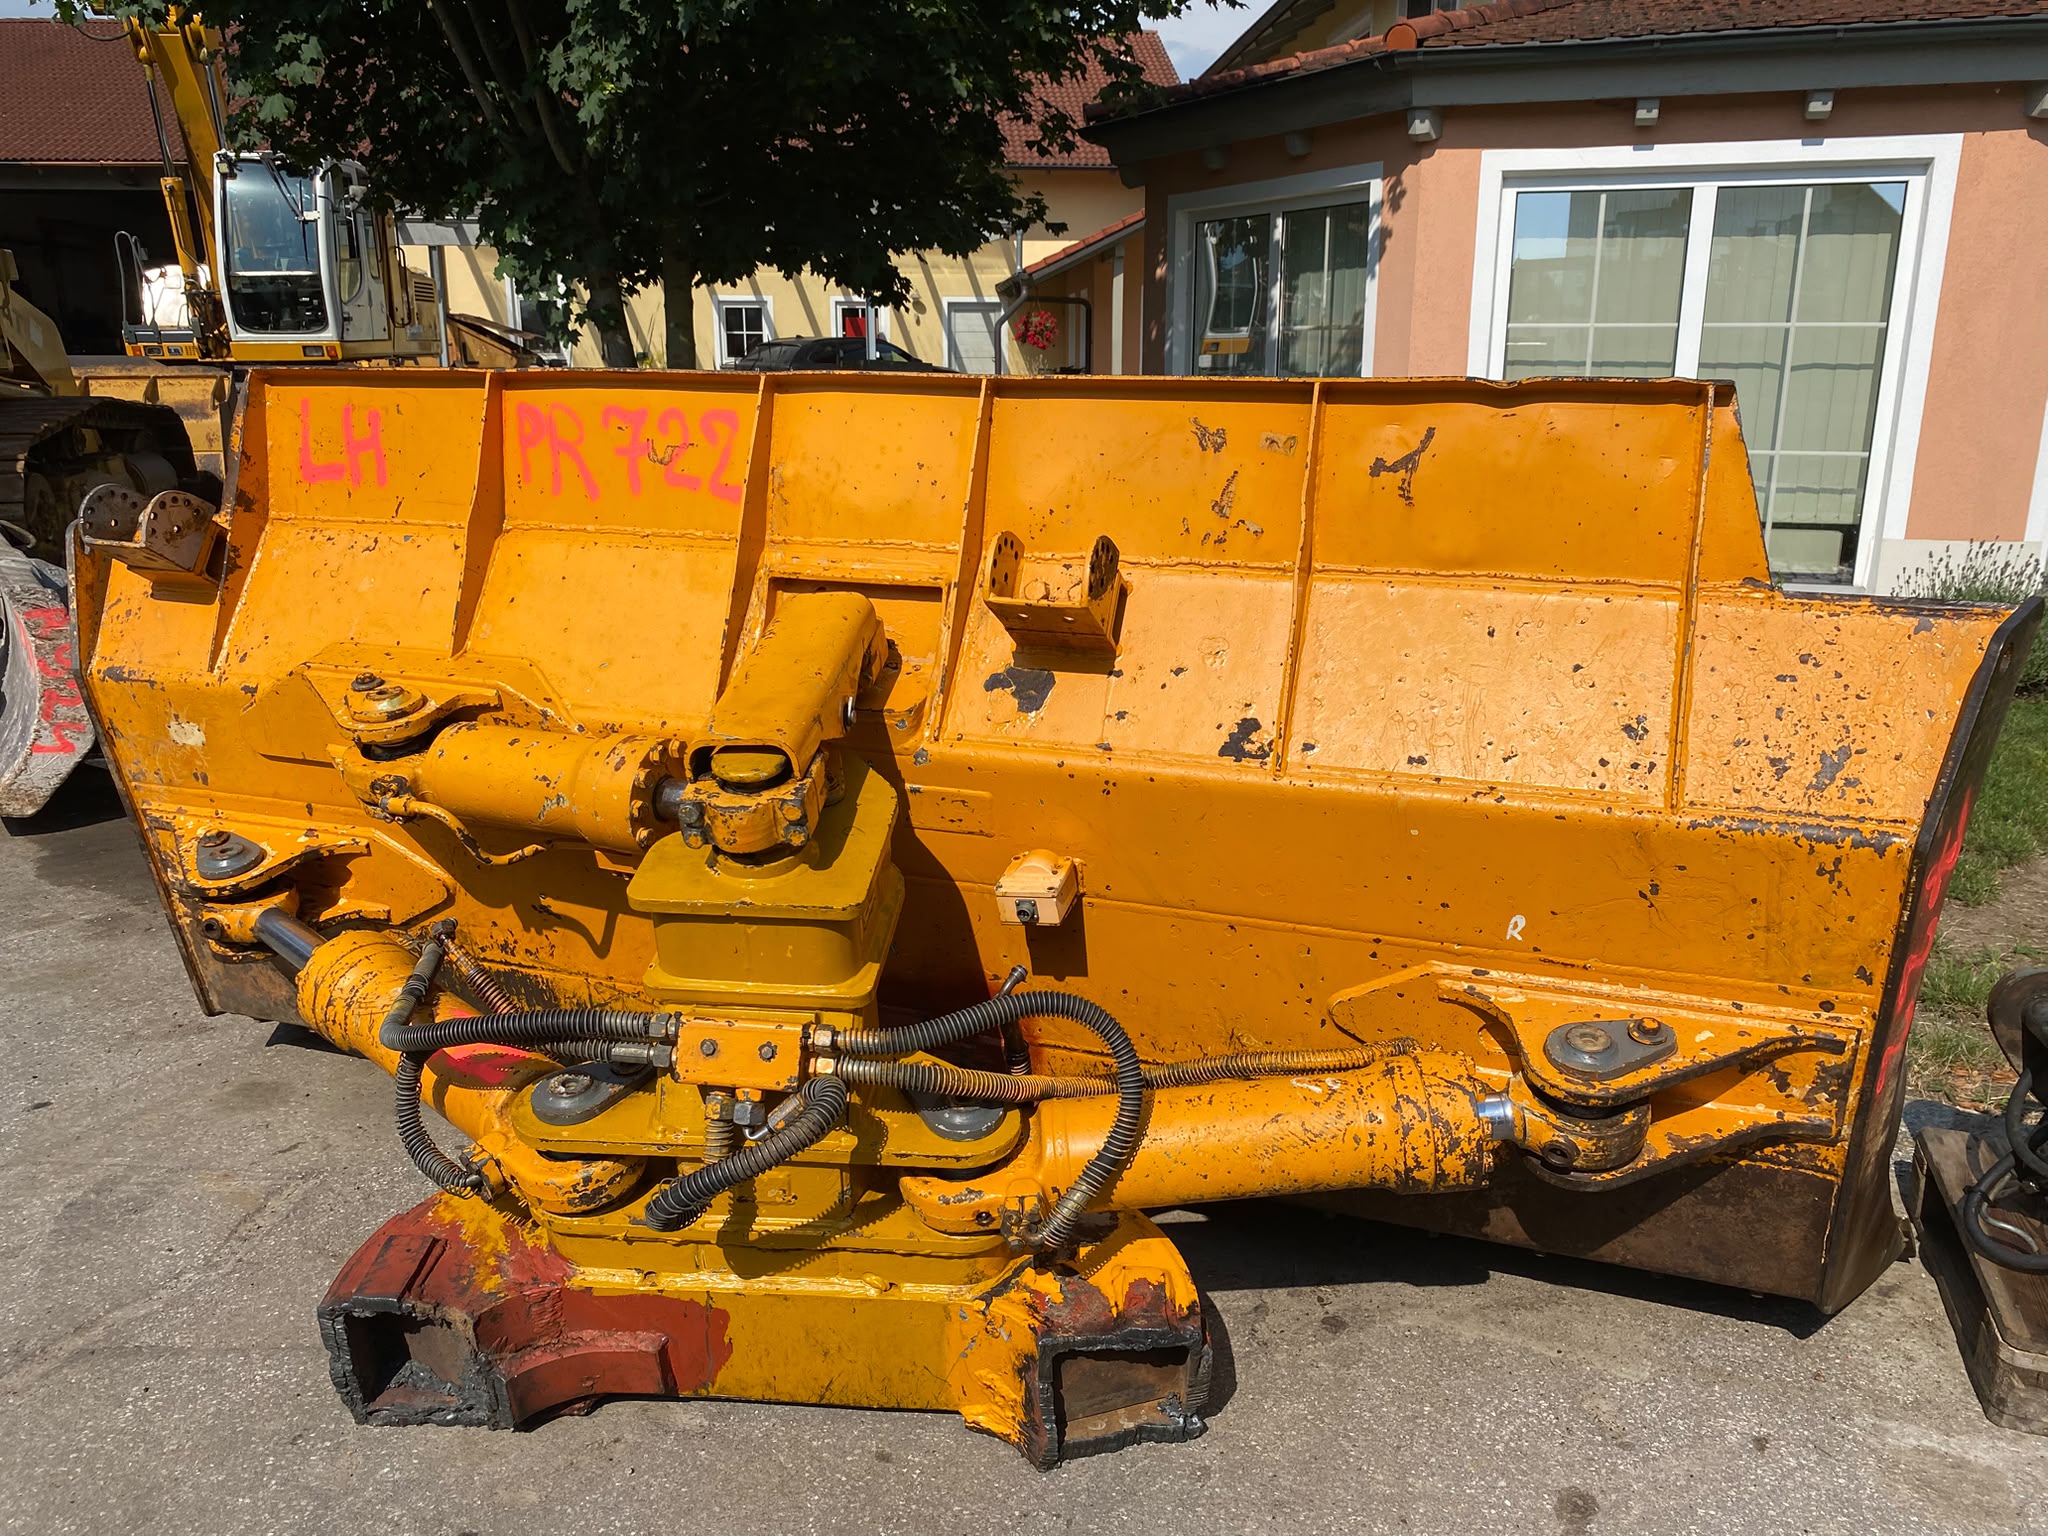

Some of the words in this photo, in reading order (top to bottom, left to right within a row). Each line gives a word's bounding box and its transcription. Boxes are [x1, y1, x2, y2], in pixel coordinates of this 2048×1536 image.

[300, 397, 389, 489] LH
[516, 401, 600, 502] PR
[602, 404, 743, 504] 722
[1506, 914, 1527, 942] R
